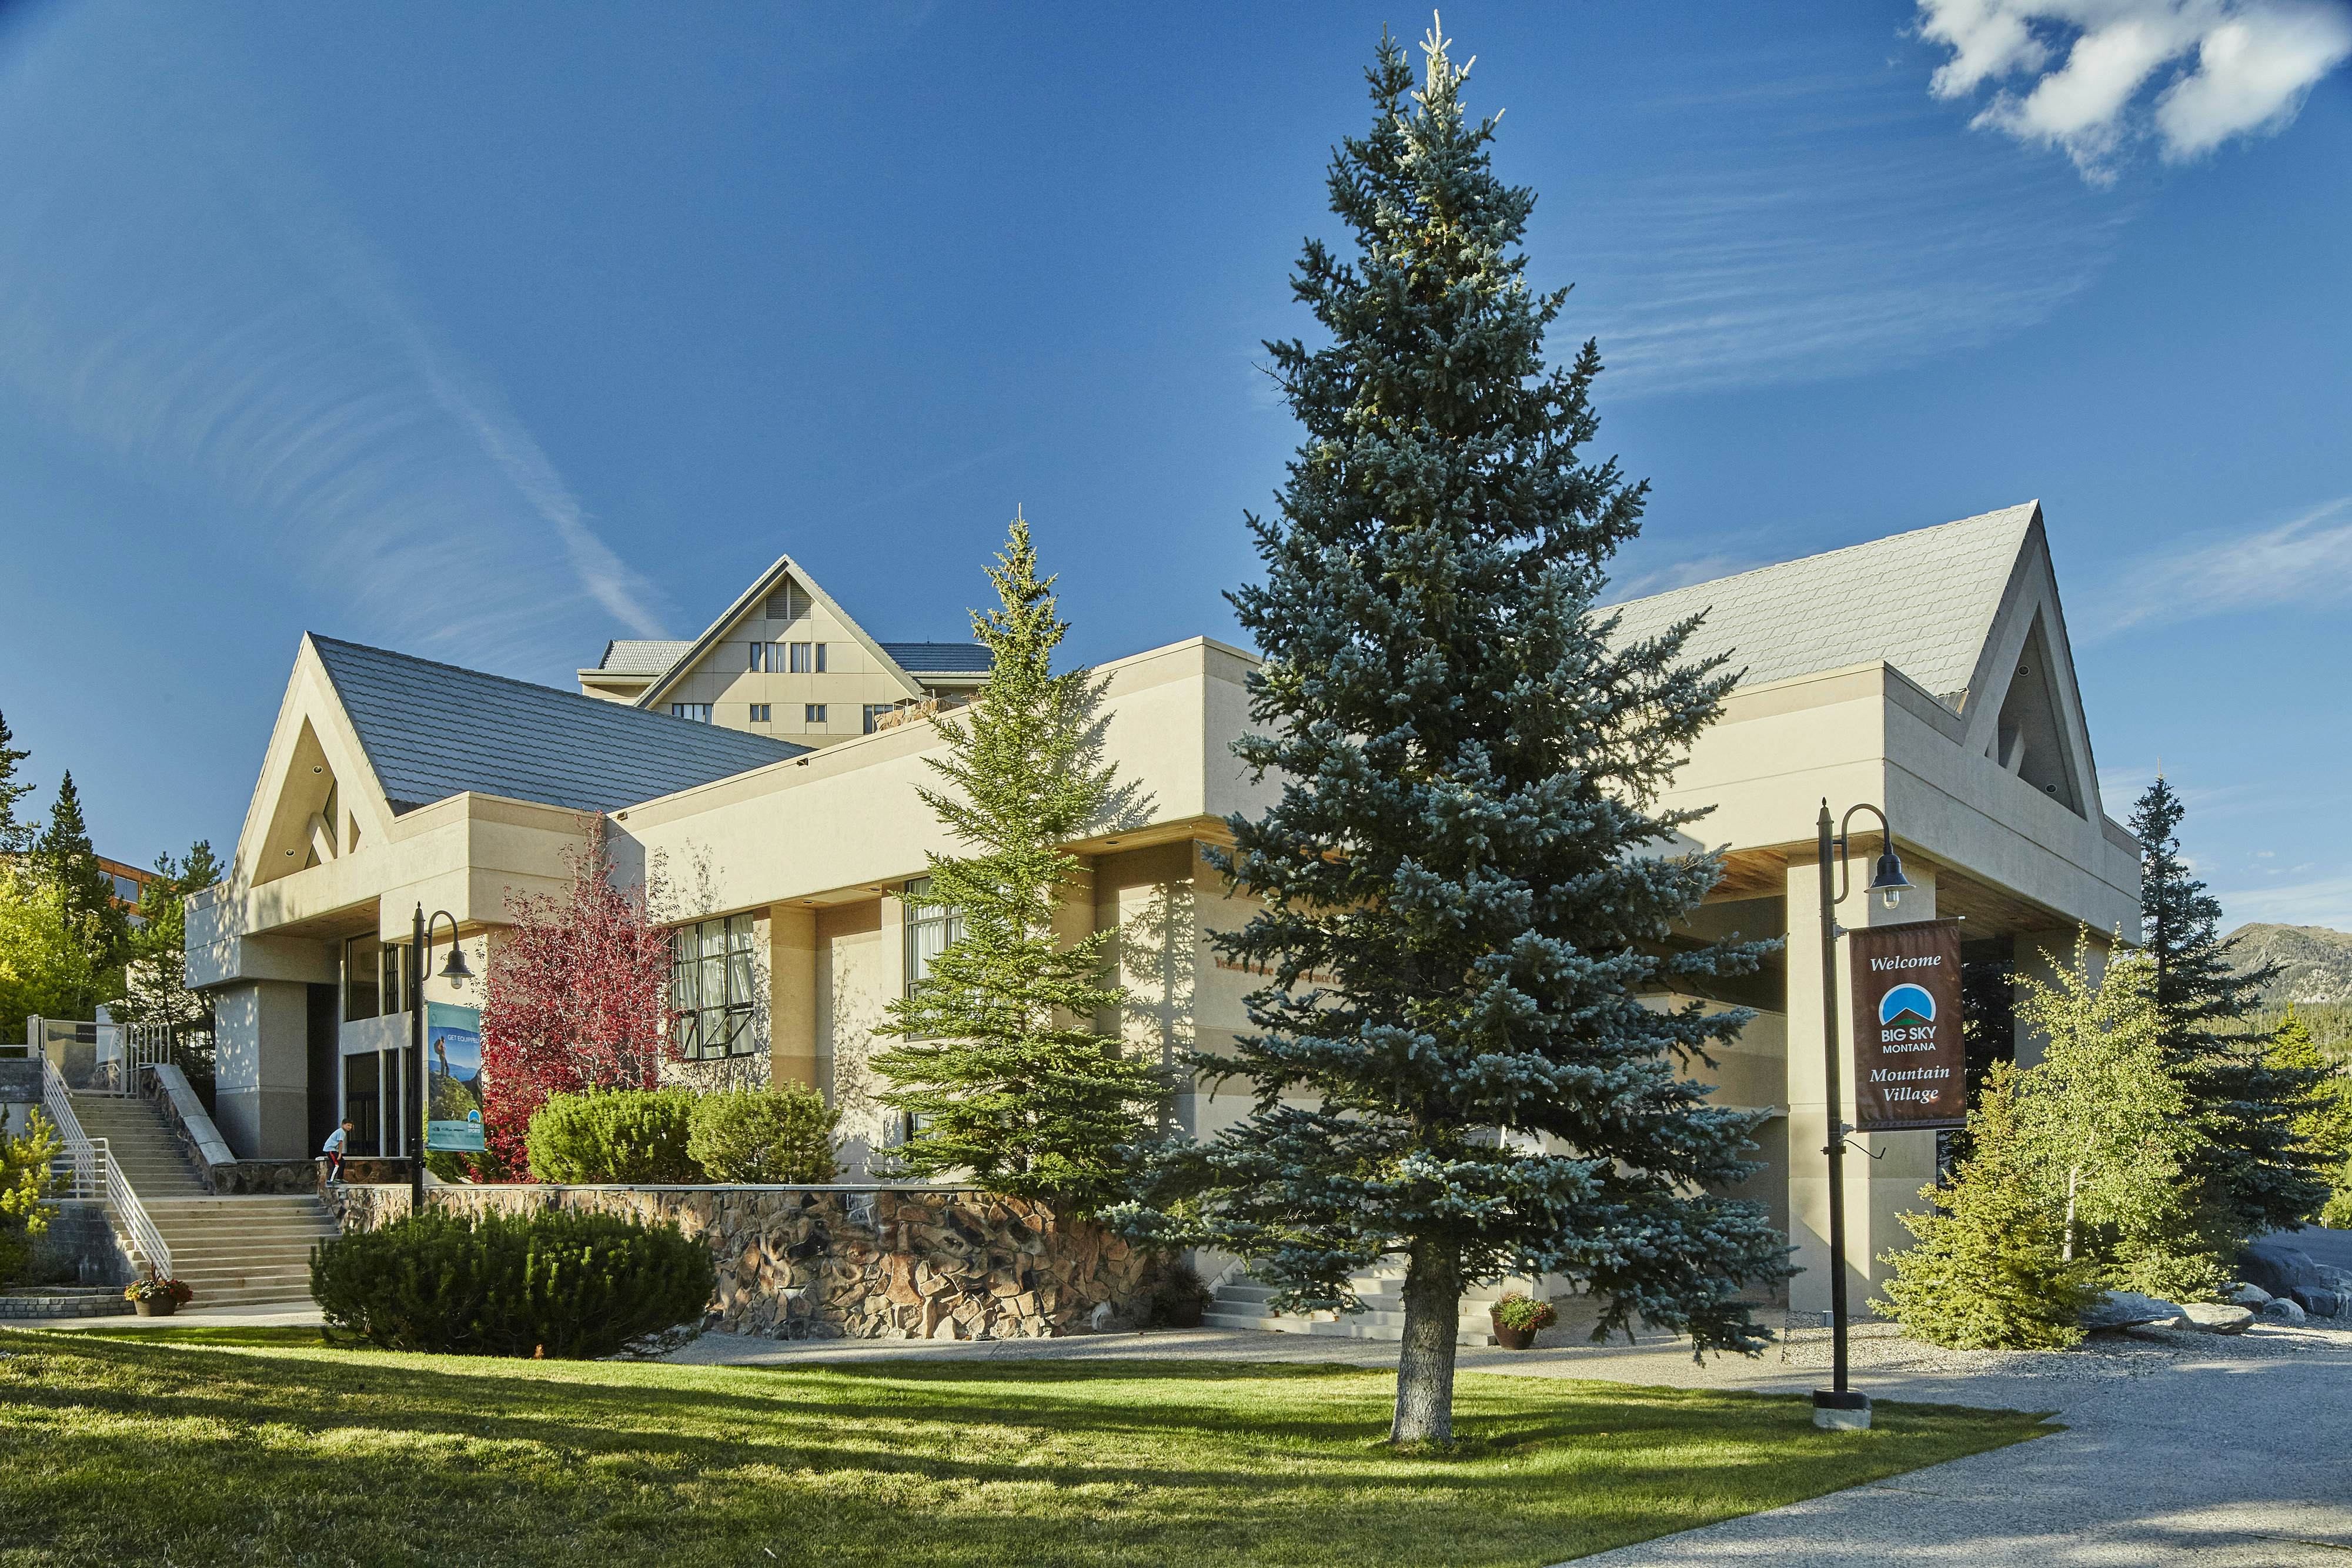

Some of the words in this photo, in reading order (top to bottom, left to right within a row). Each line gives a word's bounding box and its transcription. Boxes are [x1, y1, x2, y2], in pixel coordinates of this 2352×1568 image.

[1870, 954, 1942, 971] Welcome
[1882, 1028, 1906, 1043] BIG
[1909, 1026, 1937, 1040] SKY
[1883, 1042, 1936, 1054] MONTANA
[1870, 1065, 1950, 1082] Mountain
[1883, 1088, 1939, 1104] Village
